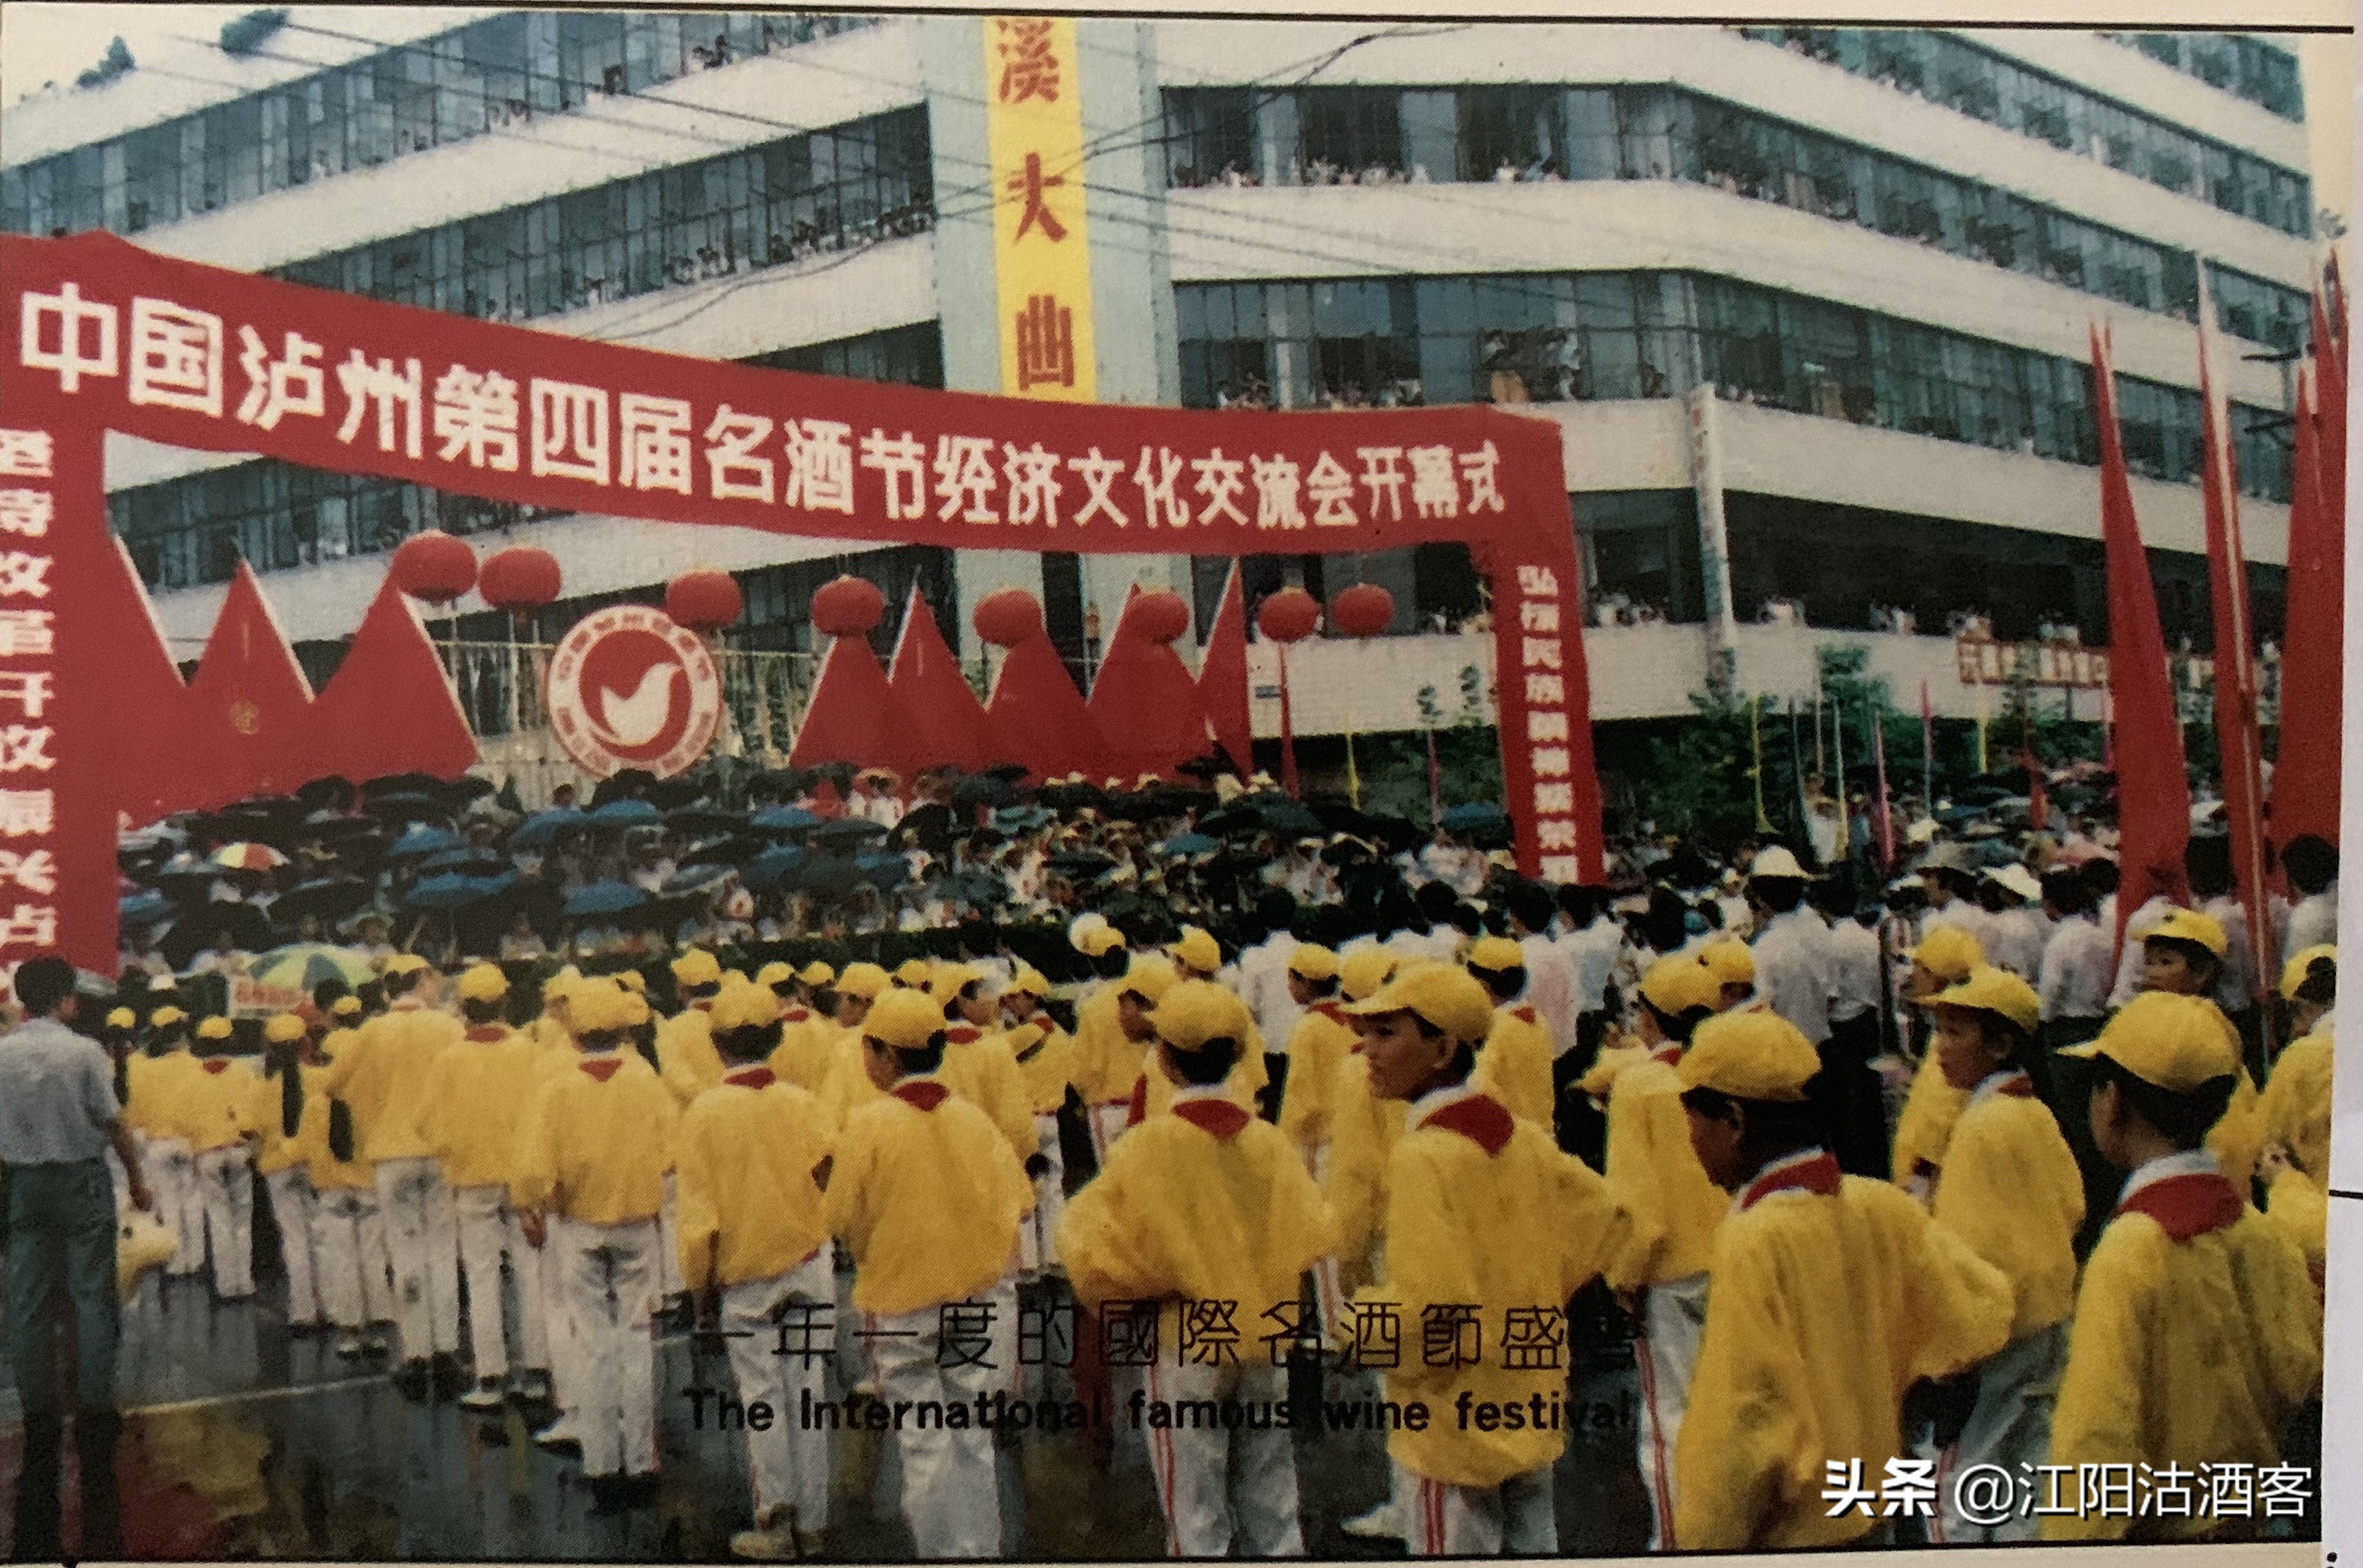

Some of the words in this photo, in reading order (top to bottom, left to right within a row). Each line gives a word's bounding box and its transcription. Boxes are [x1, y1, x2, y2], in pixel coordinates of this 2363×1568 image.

[21, 281, 1505, 530] 中国泸州第四届名酒节经济文化交流会开幕式
